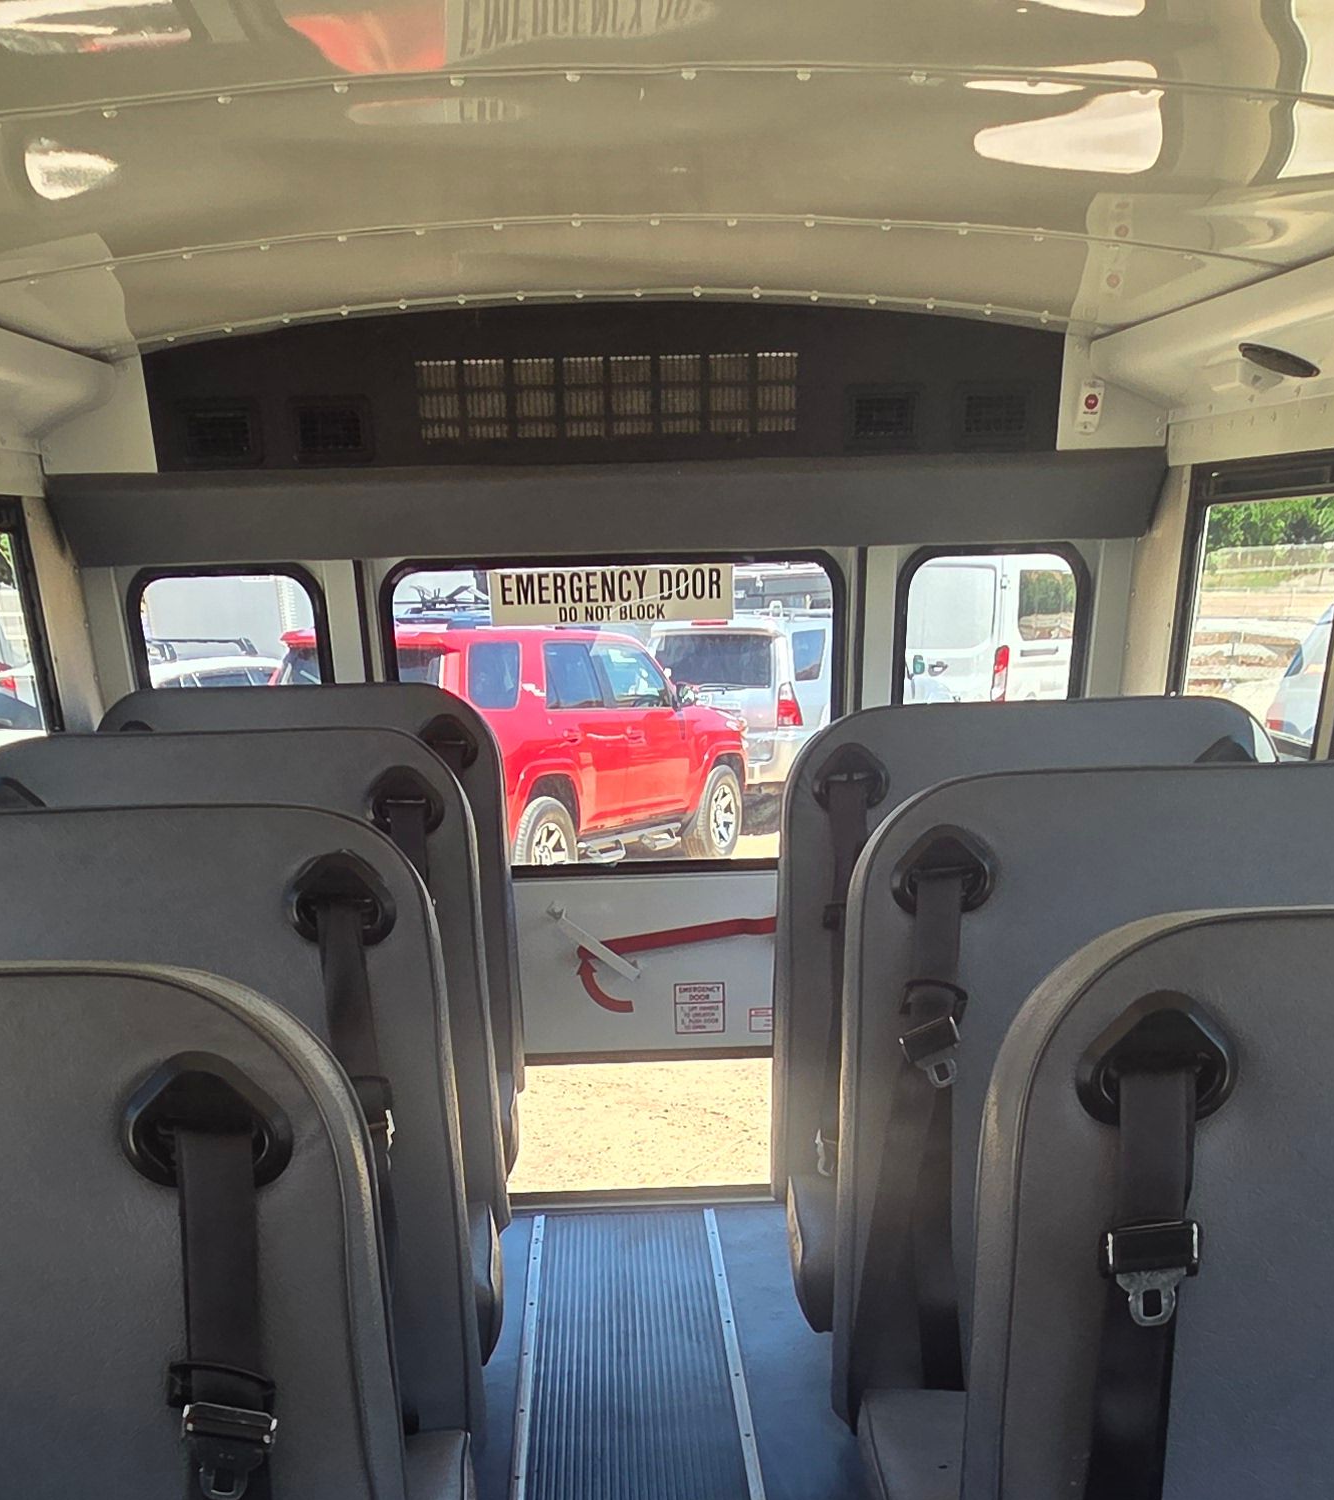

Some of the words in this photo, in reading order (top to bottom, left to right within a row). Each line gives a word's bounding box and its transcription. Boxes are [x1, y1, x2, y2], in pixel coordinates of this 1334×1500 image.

[499, 569, 649, 606] EMERGENCY
[660, 567, 722, 602] DOOR
[558, 607, 577, 623] DO
[585, 605, 612, 622] NOT
[620, 603, 666, 621] BLOCK
